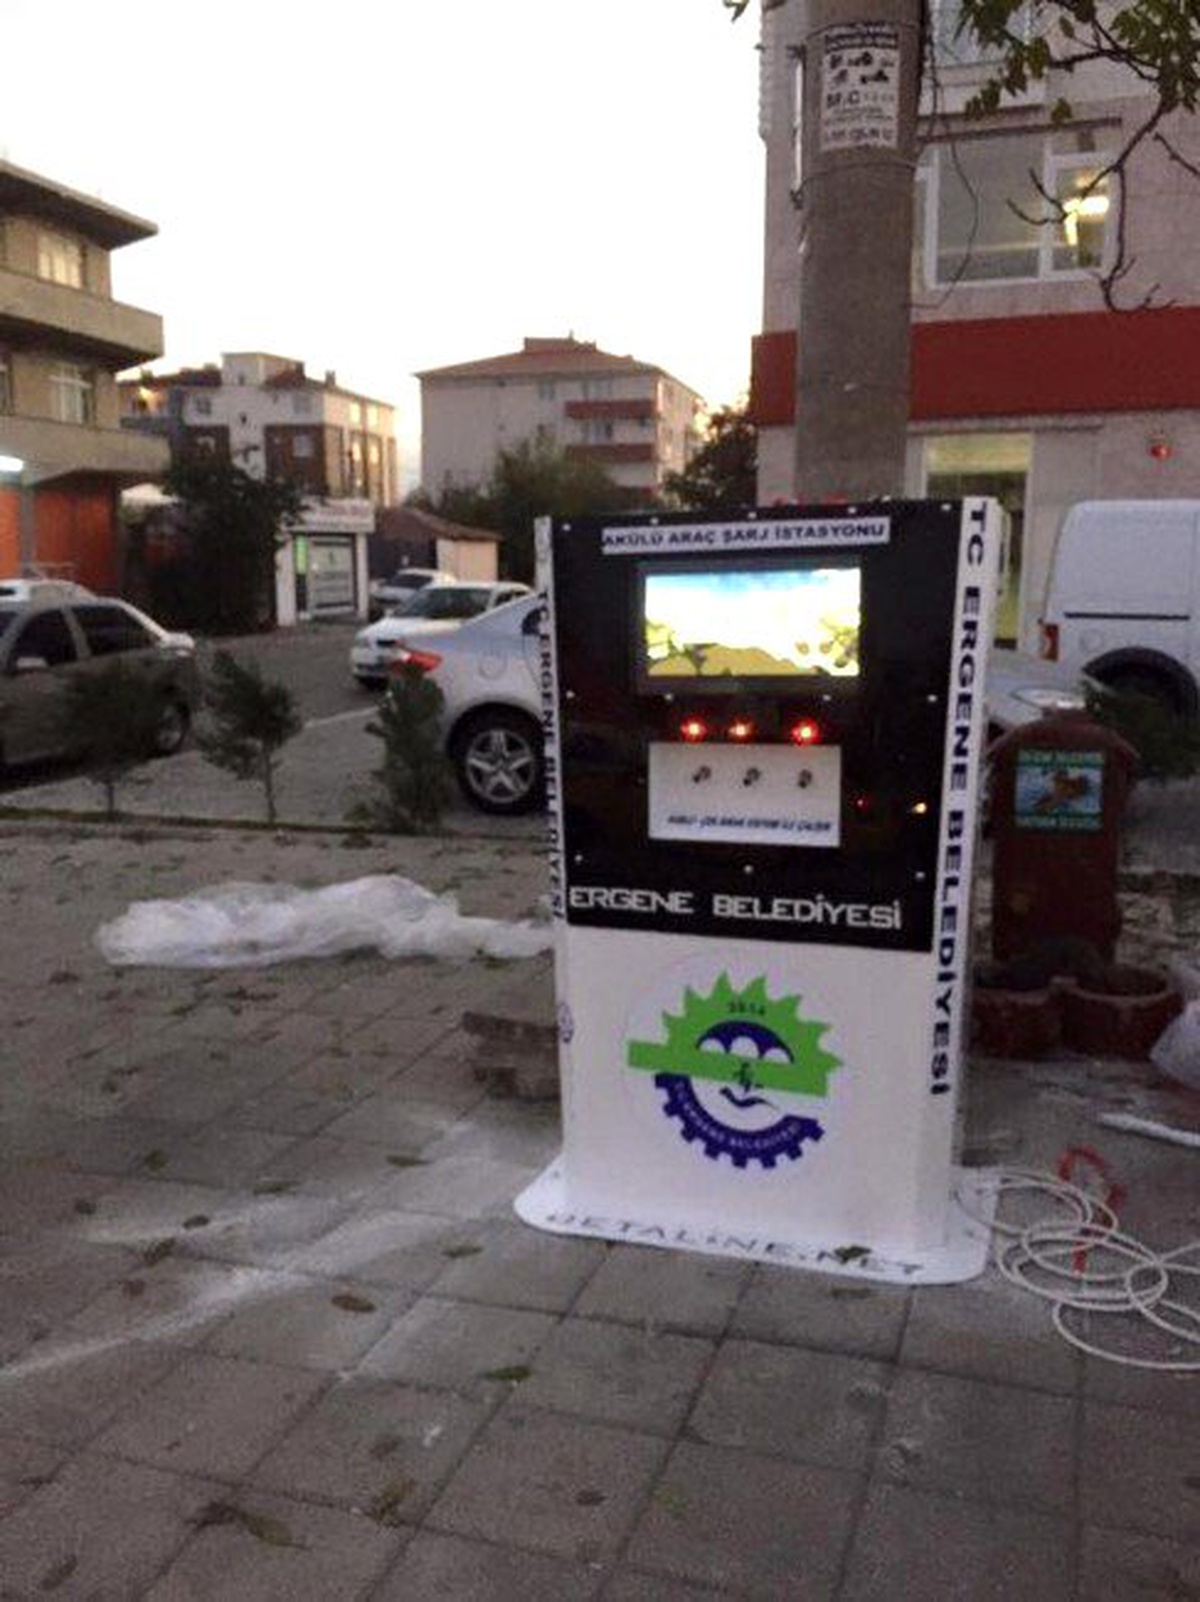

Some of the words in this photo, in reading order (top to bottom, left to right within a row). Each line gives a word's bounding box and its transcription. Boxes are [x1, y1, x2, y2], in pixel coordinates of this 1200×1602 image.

[967, 501, 987, 566] TC
[951, 586, 981, 791] ERGENE
[569, 886, 695, 914] ERGENE
[712, 893, 902, 930] BELEDİYESİ
[931, 810, 964, 1095] BELEDİYESİ
